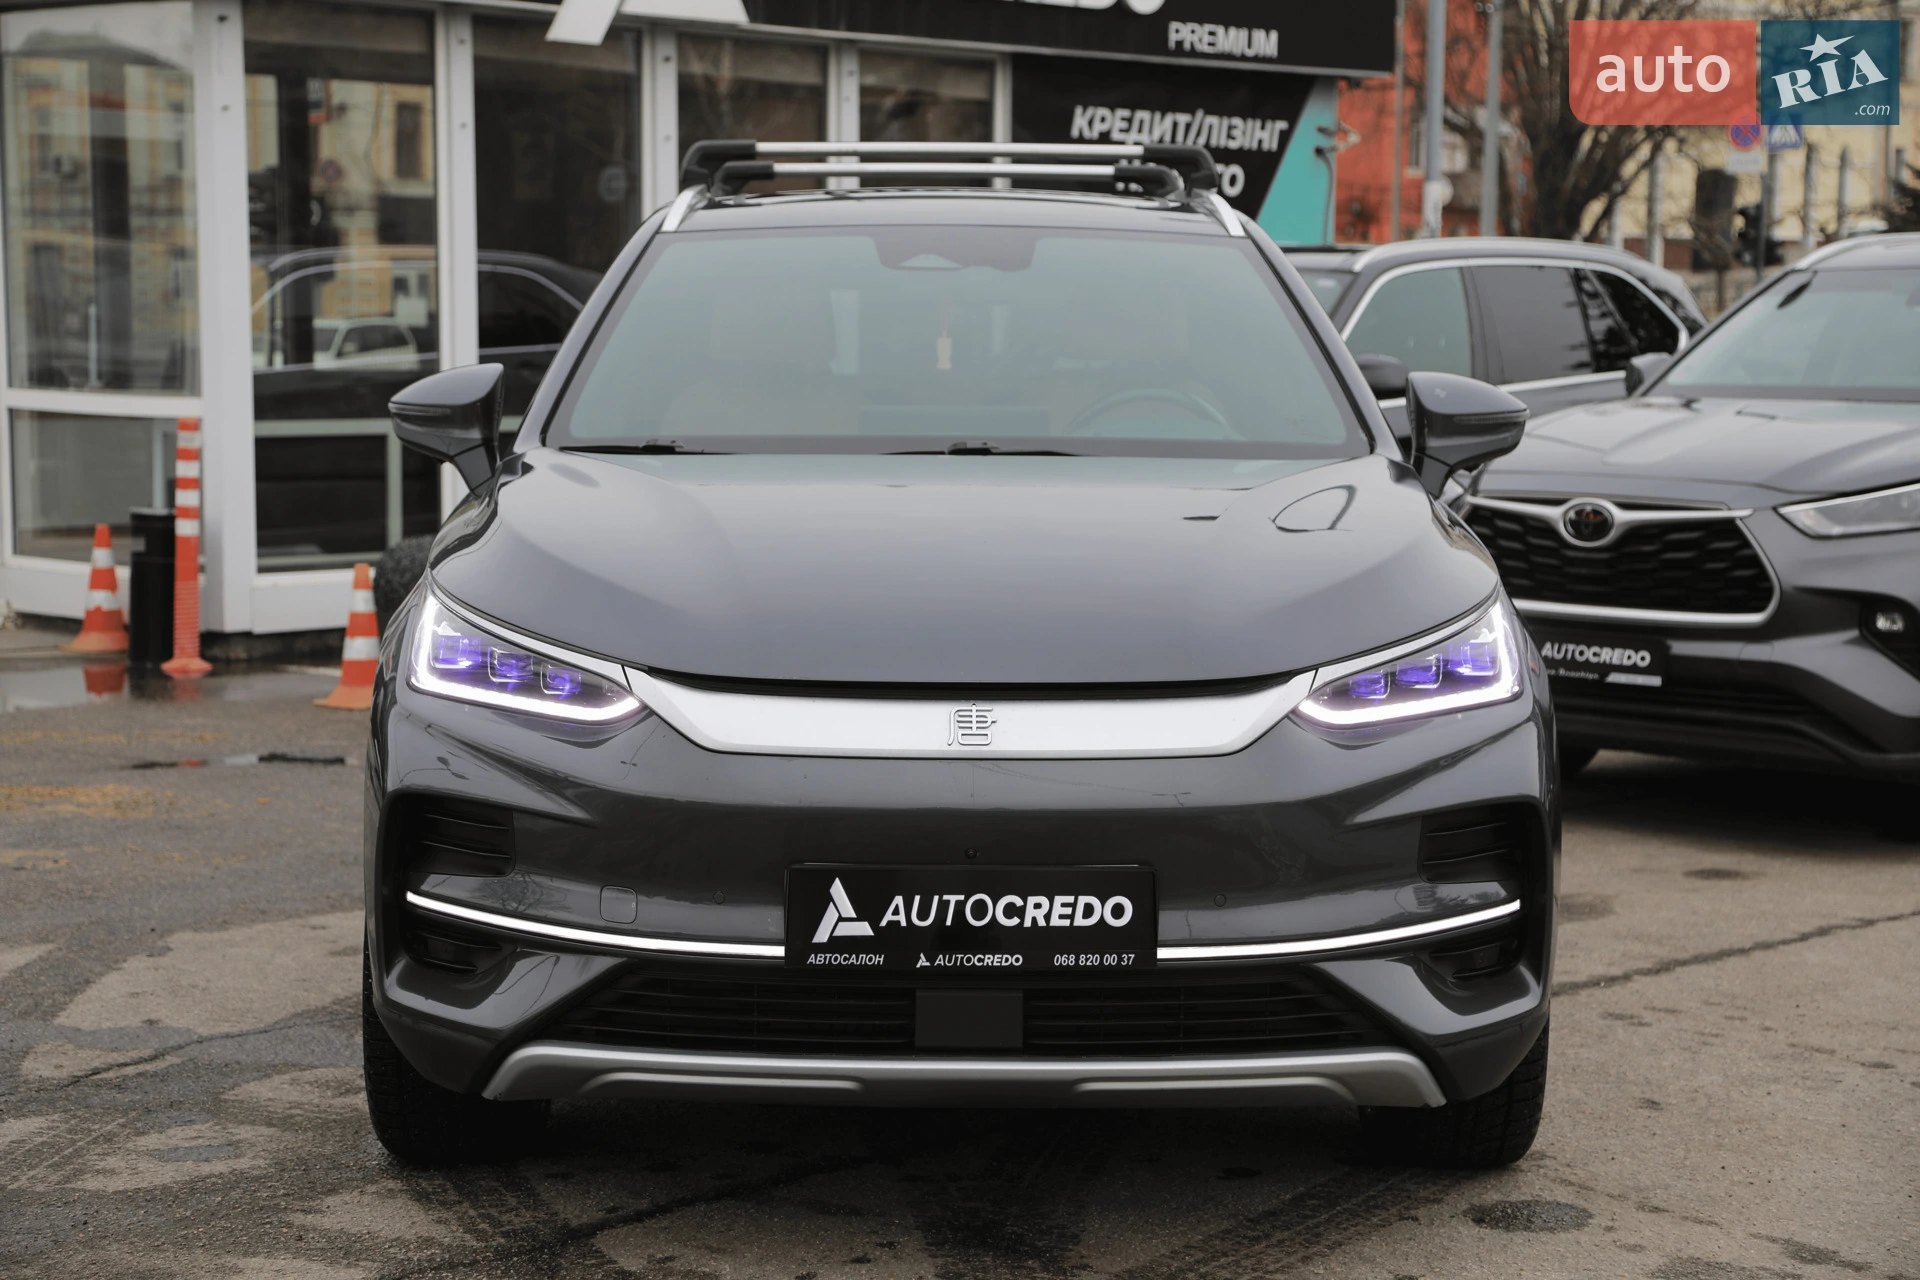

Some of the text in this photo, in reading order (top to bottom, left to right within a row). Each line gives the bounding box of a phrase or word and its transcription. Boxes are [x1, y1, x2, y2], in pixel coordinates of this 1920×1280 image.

[1168, 21, 1279, 59] PREMIUM
[1070, 104, 1290, 152] КРЕДИТ/ЛІЗІНГ
[1540, 641, 1652, 668] AUTOCREDO
[947, 703, 998, 747] 唐
[878, 892, 1134, 928] AUTOCREDO
[806, 953, 885, 966] АВТОСАЛОН
[933, 953, 1024, 967] AUTOCREDO
[1053, 953, 1136, 966] 068 820 00 37
